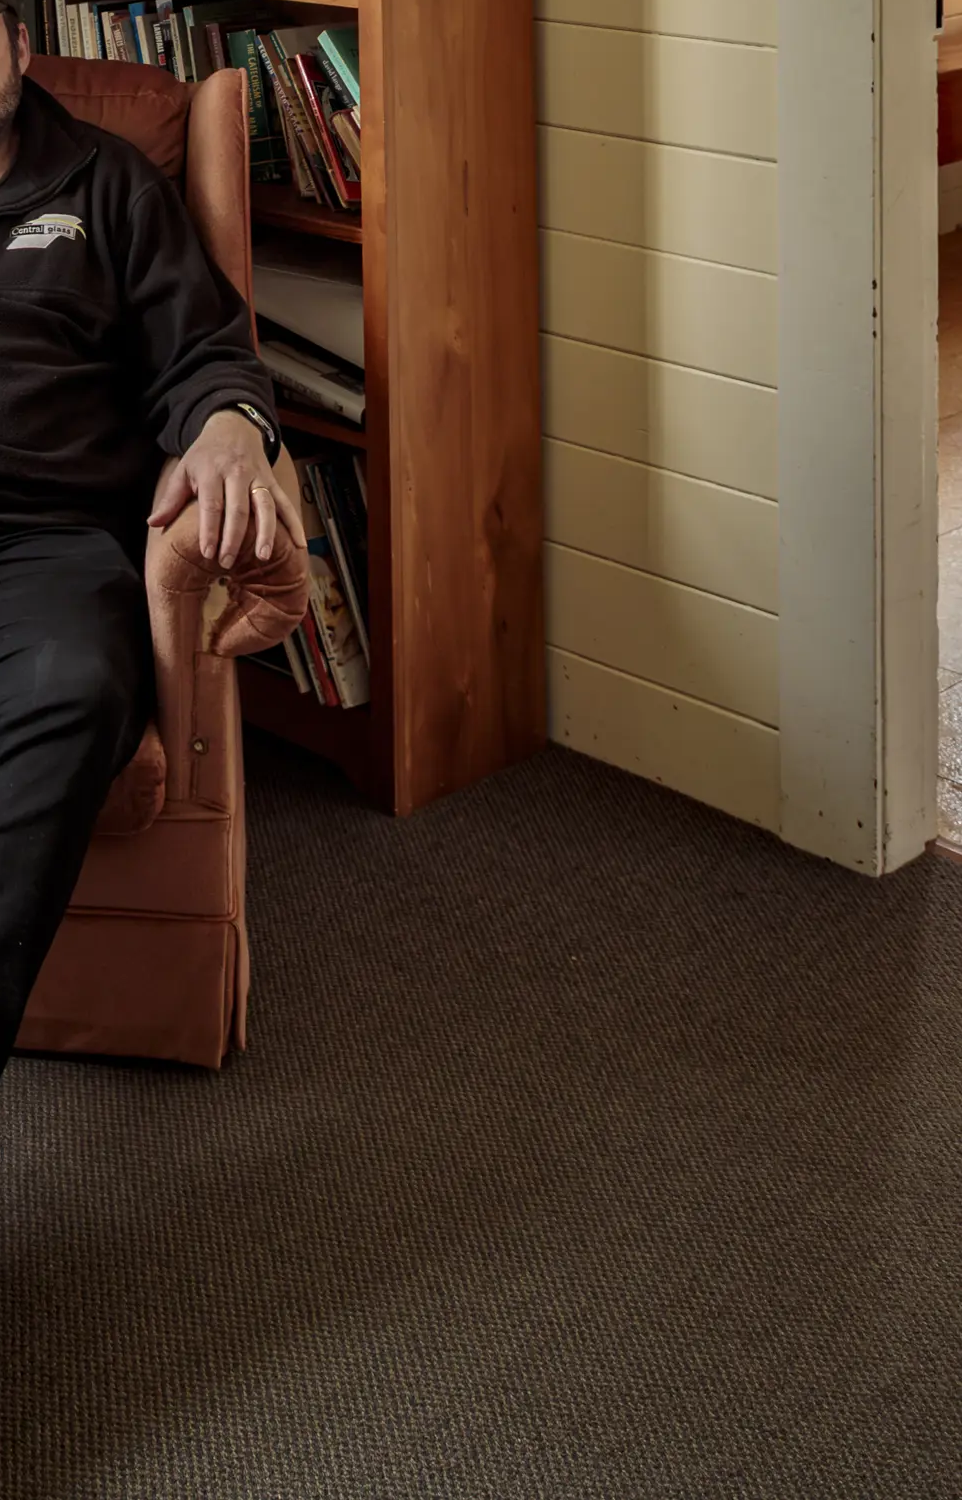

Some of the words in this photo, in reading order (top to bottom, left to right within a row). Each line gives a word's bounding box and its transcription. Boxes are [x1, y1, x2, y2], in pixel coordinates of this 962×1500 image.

[152, 22, 164, 53] LANDFALL
[245, 43, 255, 55] THE
[246, 56, 262, 98] CATECHISM
[321, 58, 335, 76] david
[329, 74, 344, 92] lange
[272, 79, 288, 104] DAVID
[12, 225, 43, 235] Central
[47, 226, 71, 235] glass
